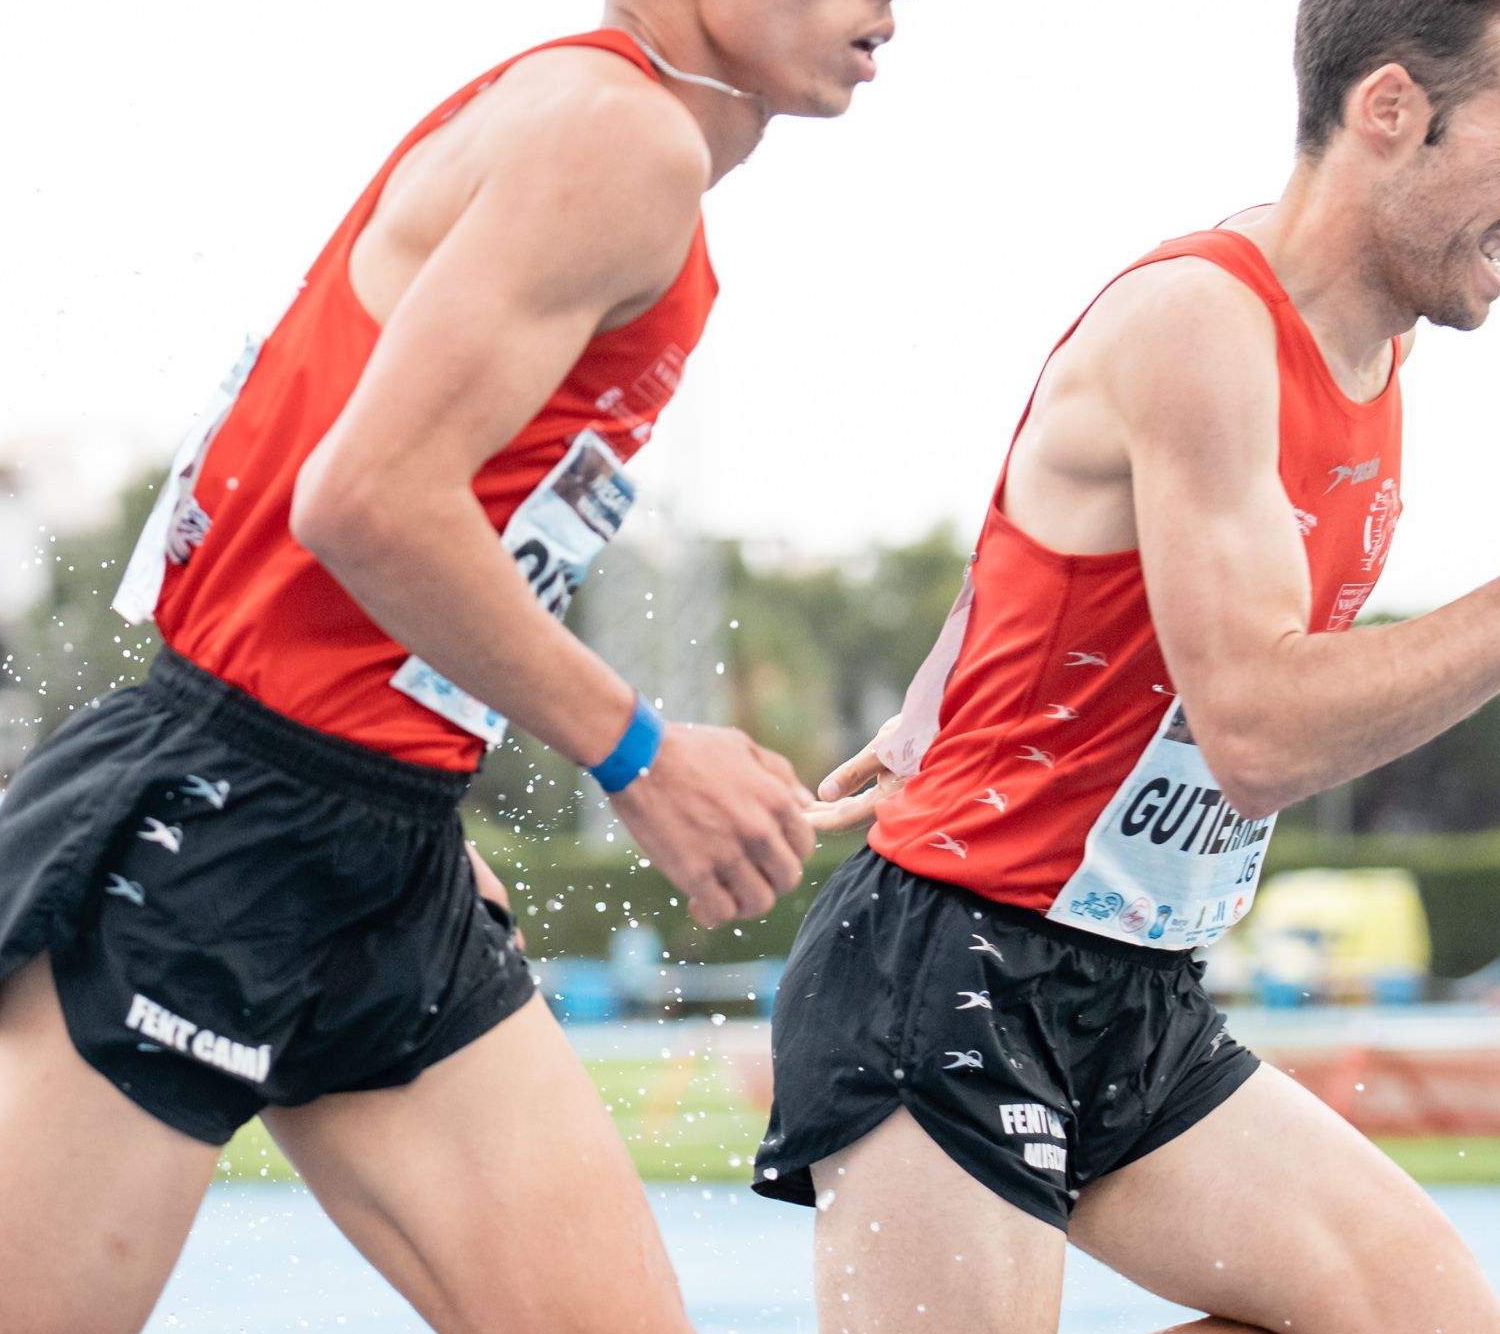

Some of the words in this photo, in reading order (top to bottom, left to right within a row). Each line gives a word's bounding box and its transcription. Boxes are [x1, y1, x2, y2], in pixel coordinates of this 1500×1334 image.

[1235, 851, 1261, 885] 16
[124, 993, 198, 1053] FENT
[998, 1103, 1048, 1135] FENT
